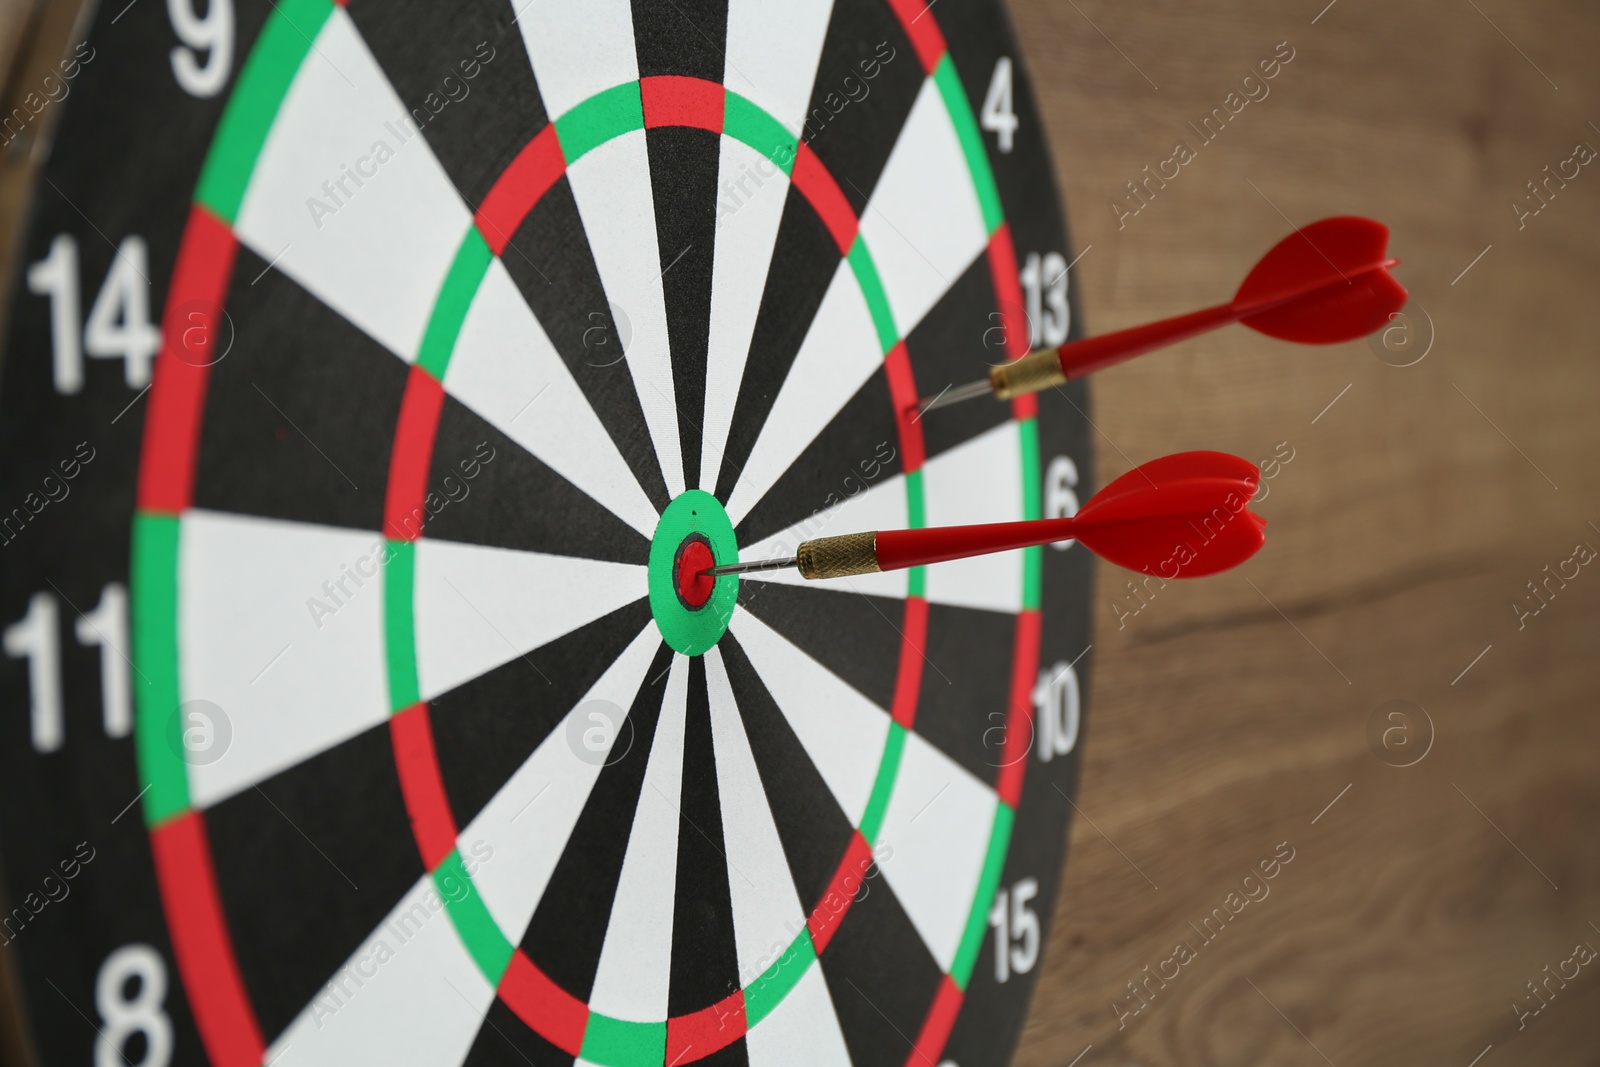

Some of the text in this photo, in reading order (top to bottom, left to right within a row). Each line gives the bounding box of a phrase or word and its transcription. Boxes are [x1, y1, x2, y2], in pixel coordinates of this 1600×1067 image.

[168, 0, 234, 97] 9
[981, 57, 1018, 152] 4
[28, 235, 161, 394] 14
[1020, 251, 1070, 349] 13
[1043, 454, 1080, 551] 6
[4, 584, 131, 753] 11
[1031, 661, 1080, 762] 10
[988, 878, 1040, 982] 15
[95, 945, 171, 1067] 8
